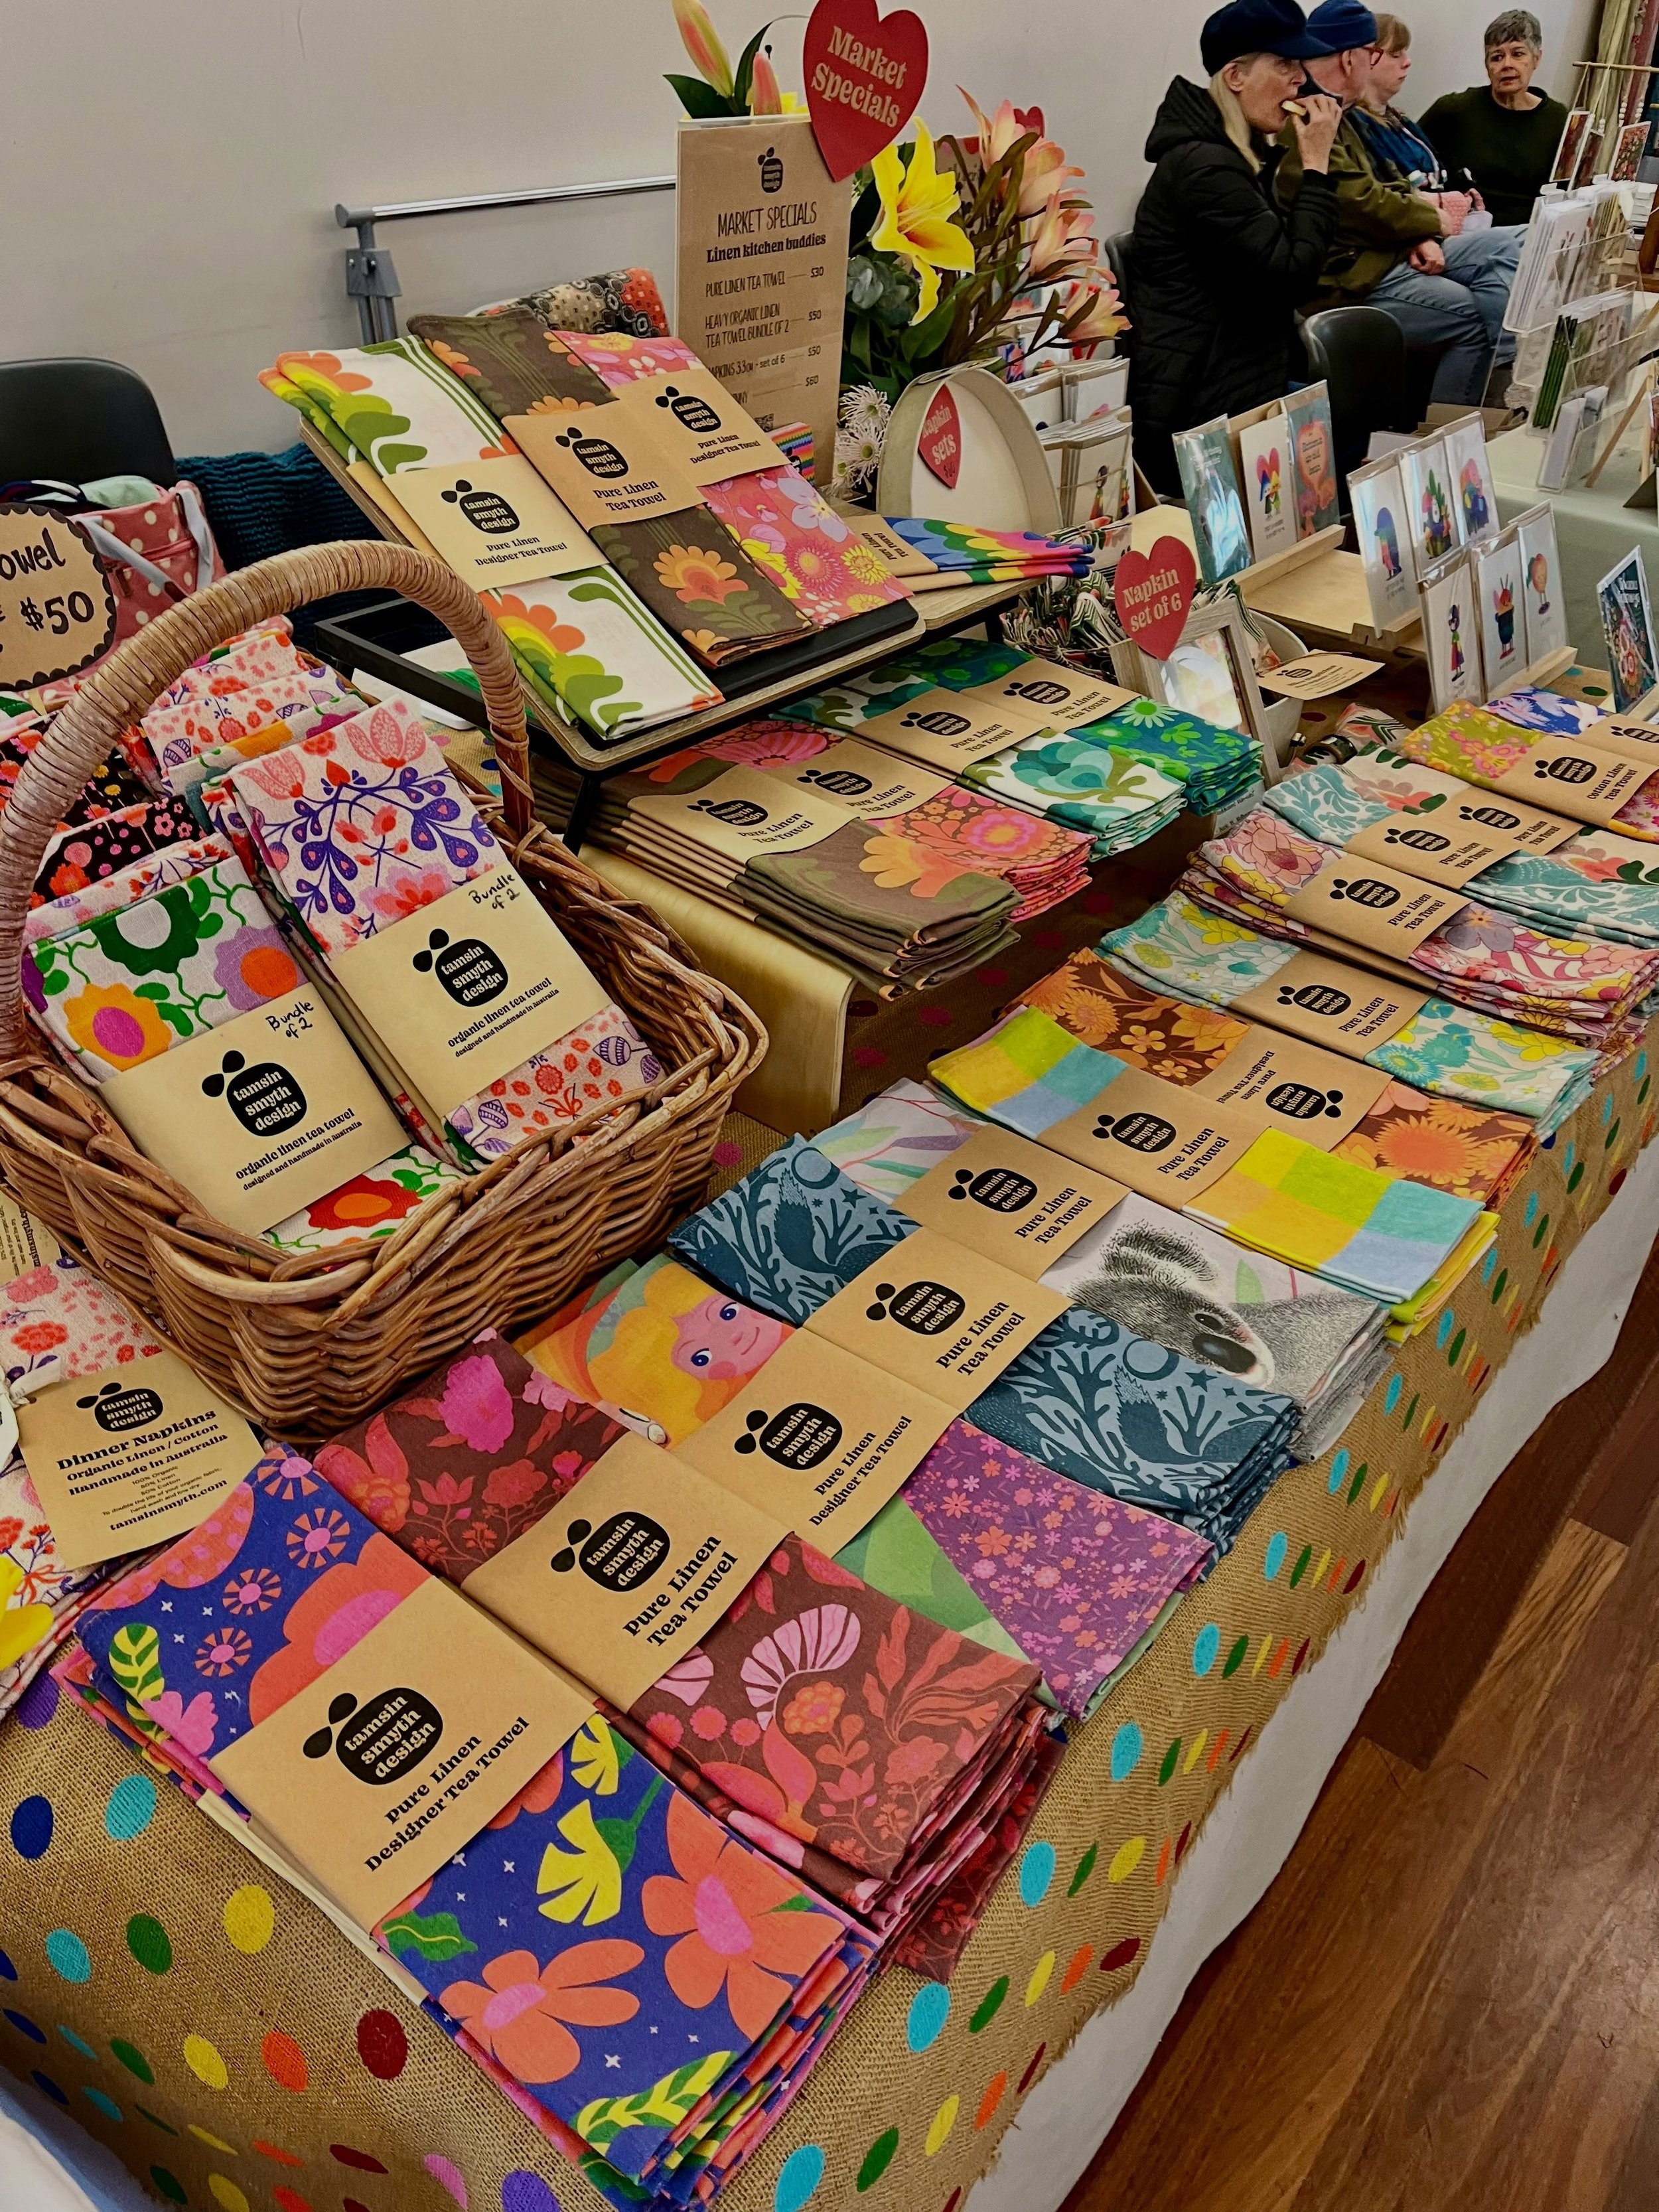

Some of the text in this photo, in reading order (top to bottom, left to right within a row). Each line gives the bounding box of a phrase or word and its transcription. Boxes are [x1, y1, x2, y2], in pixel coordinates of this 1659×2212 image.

[828, 25, 907, 91] Market
[811, 62, 901, 128] Specials
[718, 201, 817, 238] MARKET SPECIALS
[706, 233, 826, 263] Linen kitchen buddies
[706, 266, 824, 297] PURE LINEN TEA TOWEL $30
[705, 303, 780, 329] HEAVY ORGANIC LINEN
[706, 319, 789, 348] TEA TOWEL BUNDLE OF 2
[808, 309, 822, 321] $50
[760, 360, 770, 368] set
[772, 356, 779, 365] of
[780, 354, 785, 363] 6
[808, 345, 821, 356] $50
[806, 375, 818, 387] $60
[690, 439, 761, 465] Designer Tea Towel
[697, 433, 740, 449] Pure Linen
[932, 434, 956, 465] sets
[593, 479, 658, 499] Pure Linen
[606, 492, 667, 512] Tea Towel
[474, 542, 567, 566] Designer Tea Towel
[486, 535, 541, 552] Pure Linen
[1122, 569, 1180, 609] Napkin
[21, 591, 94, 634] $50
[1130, 593, 1182, 632] set of 6
[1050, 705, 1074, 716] Pure
[1073, 690, 1101, 706] Linen
[1065, 696, 1112, 720] Tea Towel
[846, 784, 906, 807] Pure Linen
[883, 791, 916, 808] Towel
[1587, 763, 1627, 800] Cotton Linen
[1604, 769, 1638, 800] Tea Towel
[468, 874, 515, 904] Bundle
[492, 888, 520, 909] of 2
[1388, 894, 1432, 926] Pure Linen
[1405, 900, 1446, 930] Tea Towel
[265, 1001, 315, 1031] Bundle
[285, 1017, 313, 1038] of 2
[448, 977, 552, 1047] organic linen tea towel
[1338, 997, 1385, 1032] Pure Linen
[1356, 1003, 1400, 1037] Tea Towel
[233, 1070, 283, 1102] tamsin
[1216, 1051, 1275, 1103] Designer Tea Towel
[1240, 1070, 1276, 1100] Pure Linen
[245, 1084, 292, 1116] smyth
[254, 1099, 301, 1131] design
[236, 1108, 355, 1179] organic linen tea towel
[1157, 1128, 1215, 1174] Pure Linen
[1176, 1136, 1230, 1181] Tea Towel
[243, 1169, 275, 1191] designed
[275, 1161, 289, 1173] and
[288, 1142, 325, 1166] handmade
[323, 1136, 332, 1145] in
[1014, 1187, 1078, 1238] Pure Linen
[1035, 1196, 1092, 1244] Tea Towel
[936, 1301, 1010, 1368] Pure Linen
[957, 1312, 1026, 1376] Tea Towel
[56, 1410, 216, 1471] Dinner Napkins
[765, 1408, 809, 1449] tamsin
[782, 1417, 823, 1457] smyth
[796, 1424, 837, 1466] design
[67, 1424, 219, 1481] Organic Linen Cotton
[69, 1434, 228, 1496] Handmade in Australia
[808, 1415, 912, 1526] Designer Tea Towel
[814, 1431, 877, 1495] Pure Linen
[132, 1465, 179, 1485] 100% Organic
[157, 1478, 180, 1491] Cotton
[109, 1480, 227, 1531] tamsinsmyth.com
[585, 1518, 636, 1566] tamsin
[603, 1528, 650, 1576] smyth
[617, 1538, 664, 1586] design
[622, 1536, 722, 1637] Pure Linen
[646, 1552, 738, 1647] Tea Towel
[344, 1694, 409, 1751] tamsin
[360, 1708, 421, 1765] smyth
[375, 1721, 437, 1778] design
[364, 1716, 530, 1872] Designer Tea Towel
[384, 1735, 482, 1825] Pure Linen
